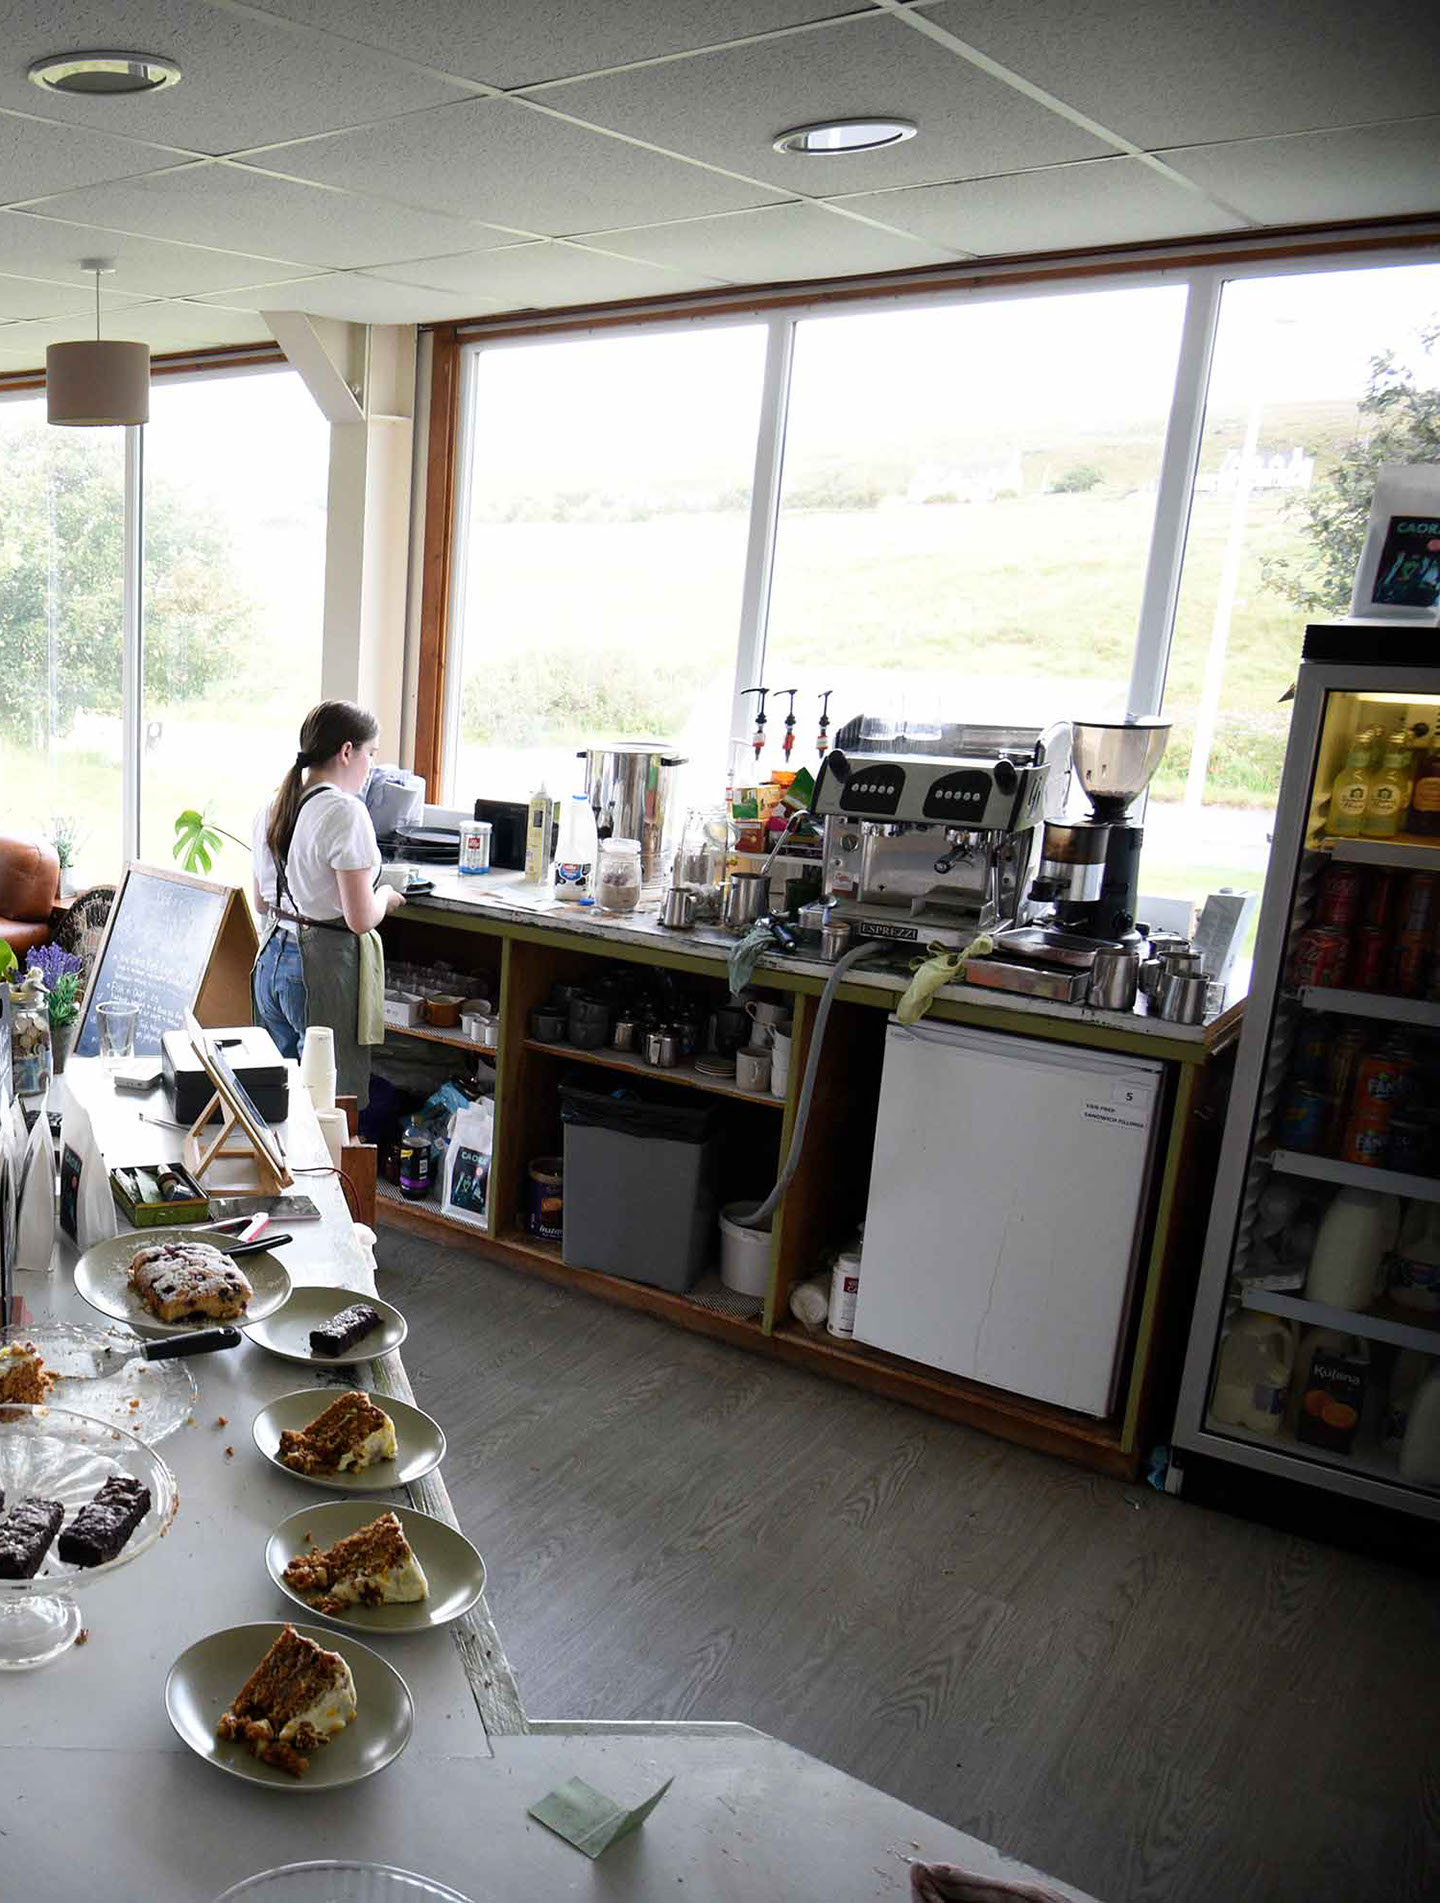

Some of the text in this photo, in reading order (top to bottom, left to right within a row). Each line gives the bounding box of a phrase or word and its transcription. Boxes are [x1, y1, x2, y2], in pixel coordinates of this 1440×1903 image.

[1397, 521, 1440, 535] CAOR
[862, 923, 916, 939] ESPREZZI
[1126, 1092, 1133, 1101] 5
